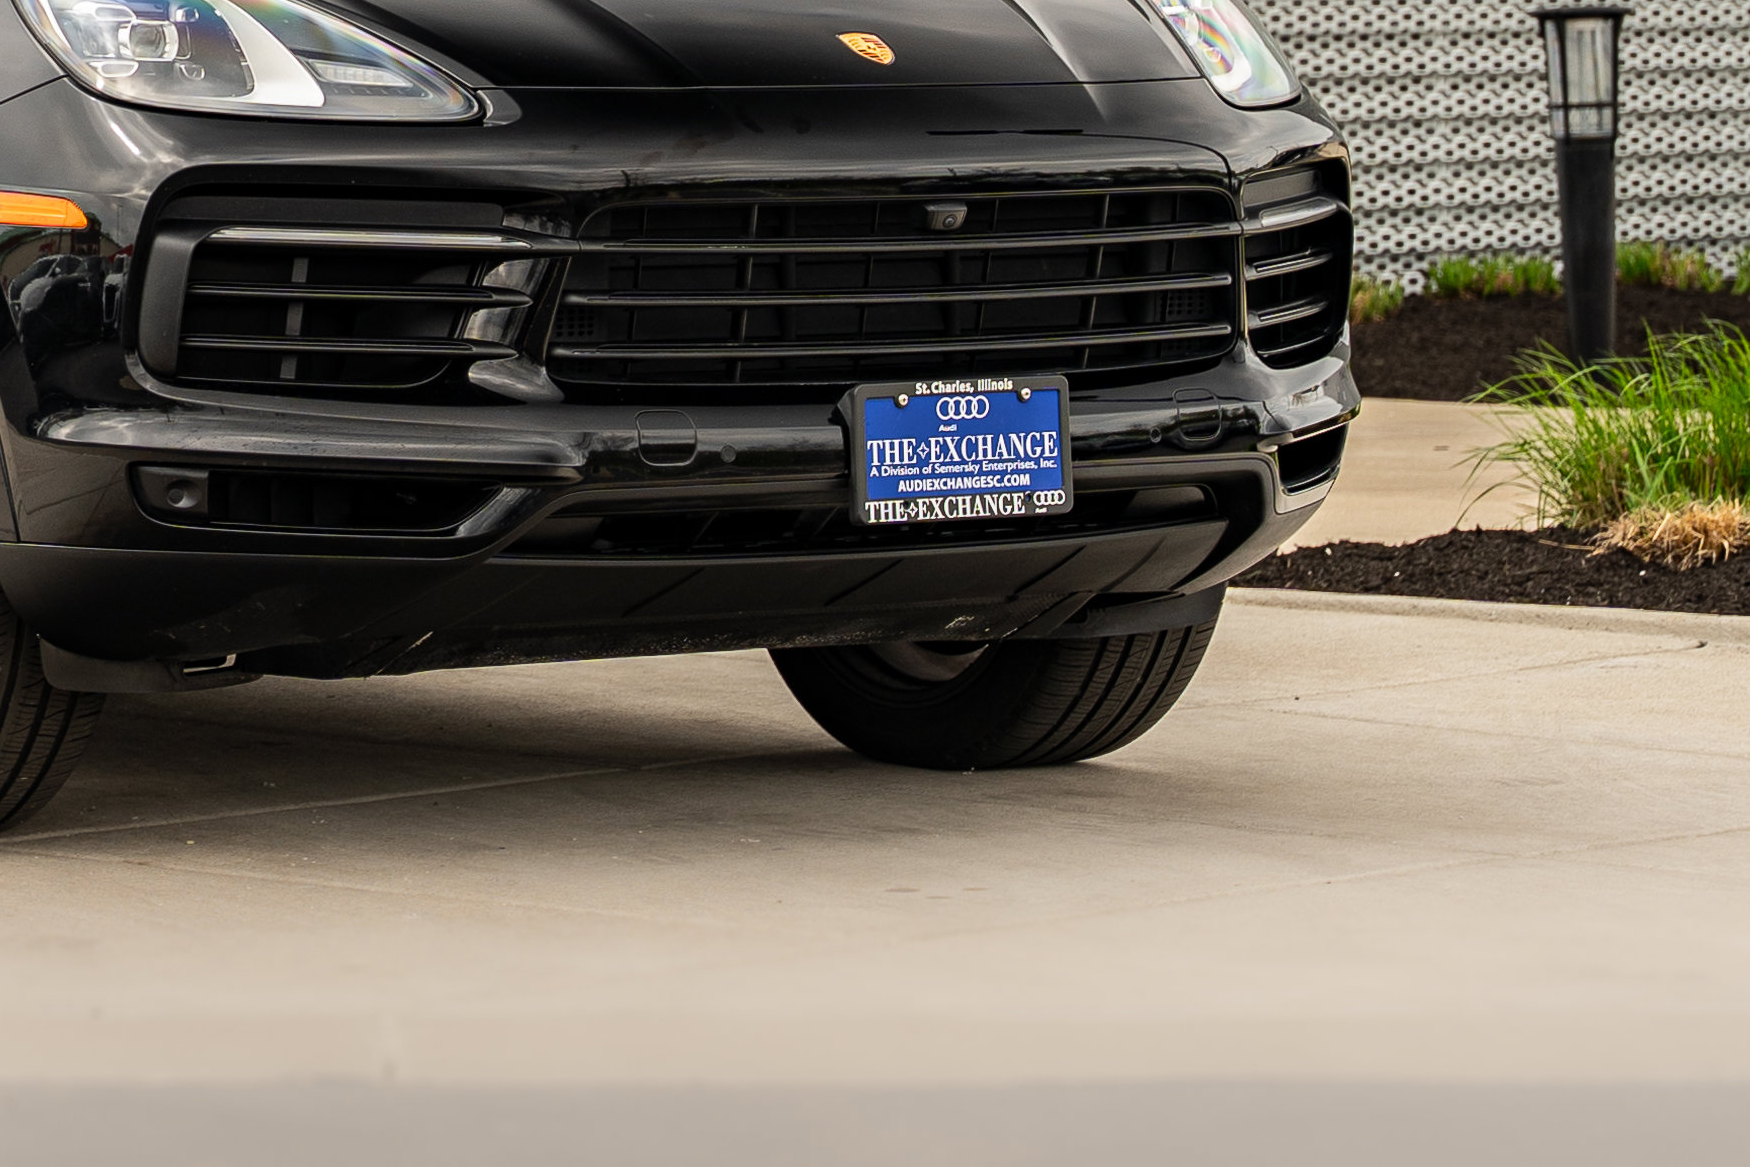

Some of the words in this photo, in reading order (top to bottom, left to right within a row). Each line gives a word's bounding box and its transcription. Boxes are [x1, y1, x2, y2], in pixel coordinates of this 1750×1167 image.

[915, 382, 930, 395] St.
[931, 380, 974, 394] Charles,
[977, 378, 1013, 392] Illinois
[867, 438, 917, 466] THE
[928, 431, 1058, 463] EXCHANGE
[870, 466, 879, 477] A
[881, 465, 920, 477] Division
[922, 463, 934, 474] of
[934, 461, 980, 475] Semersky
[982, 459, 1038, 473] Enterprises,
[1040, 458, 1057, 468] Inc.
[898, 473, 1030, 493] AUDIEXCHANGESC.COM
[865, 500, 908, 523] THE
[916, 492, 1025, 521] EXCHANGE
